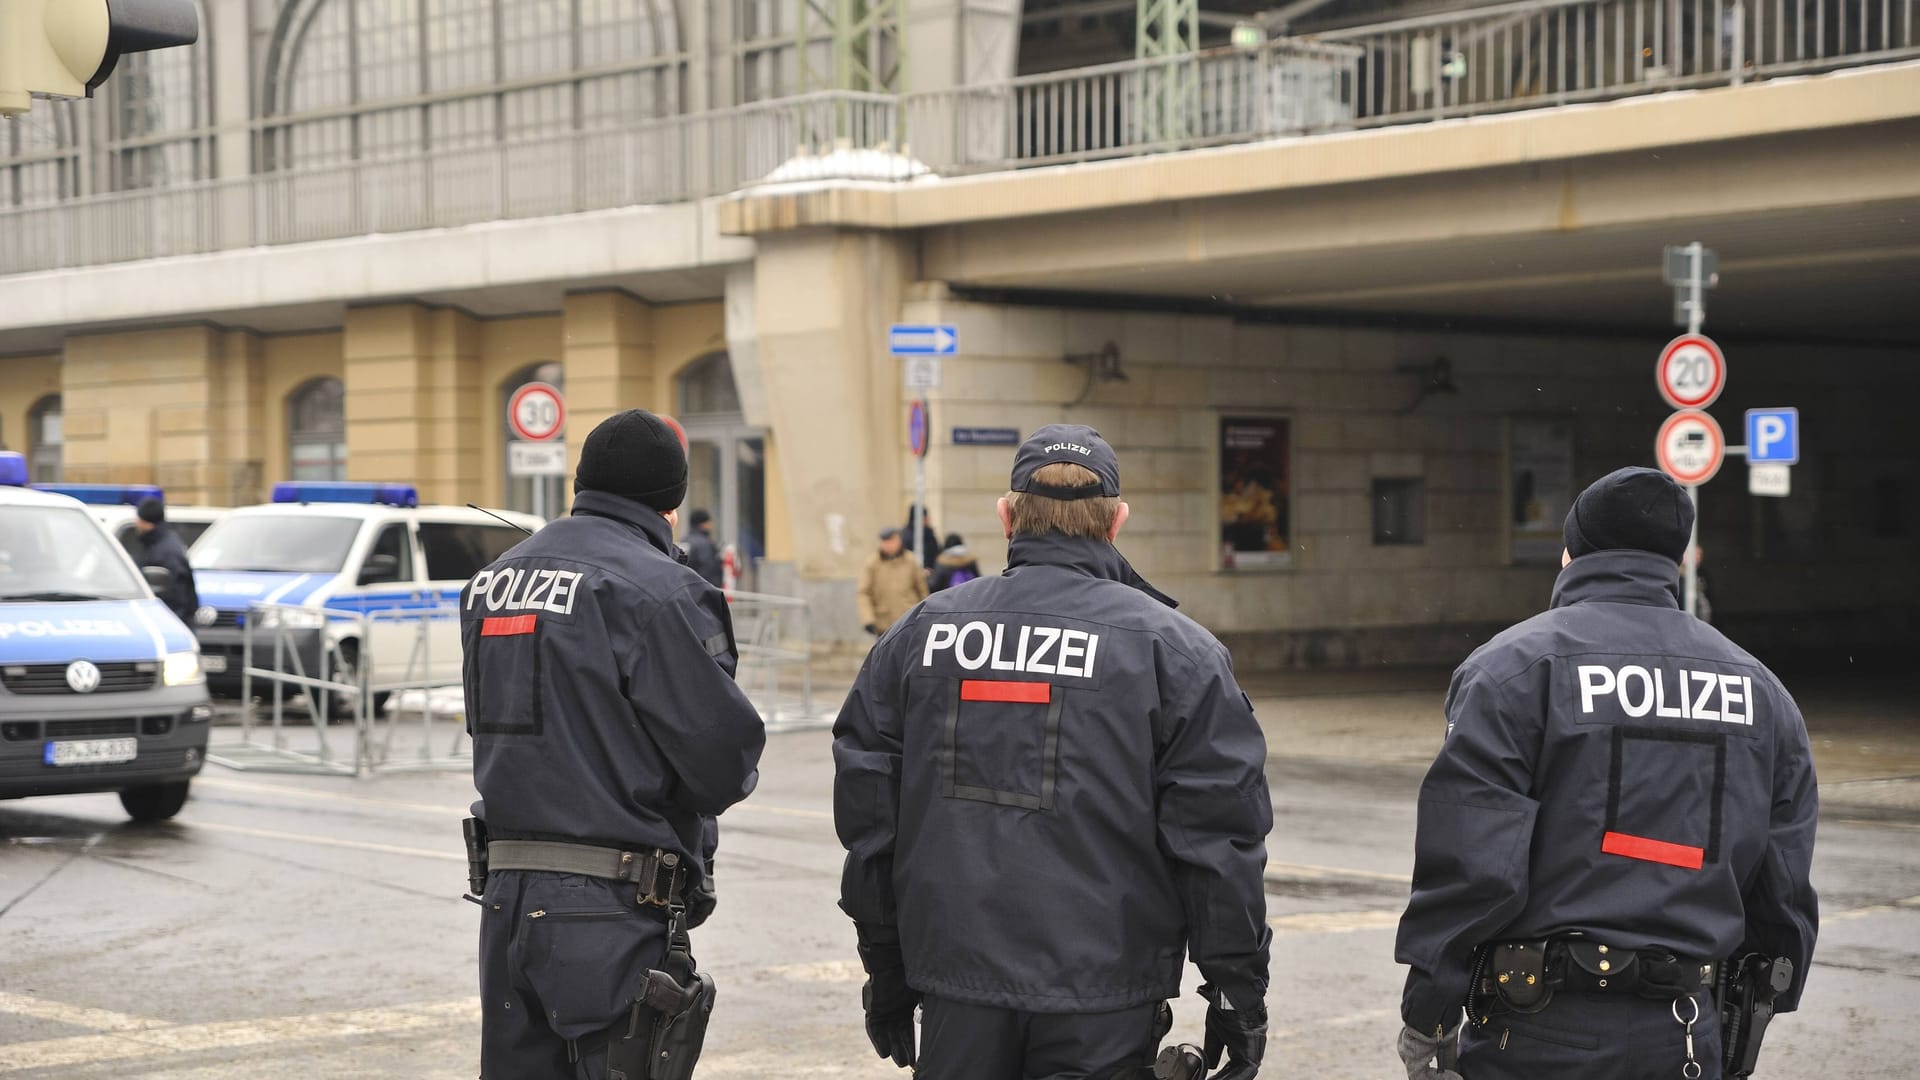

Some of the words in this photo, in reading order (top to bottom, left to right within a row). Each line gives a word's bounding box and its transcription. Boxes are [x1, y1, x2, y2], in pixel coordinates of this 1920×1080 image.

[1675, 355, 1711, 388] 20
[524, 400, 557, 427] 30
[1044, 442, 1092, 456] POLIZEI
[1756, 415, 1787, 458] P
[466, 567, 584, 615] POLIZEI
[922, 621, 1099, 678] POLIZEI
[1577, 665, 1754, 726] POLIZEI
